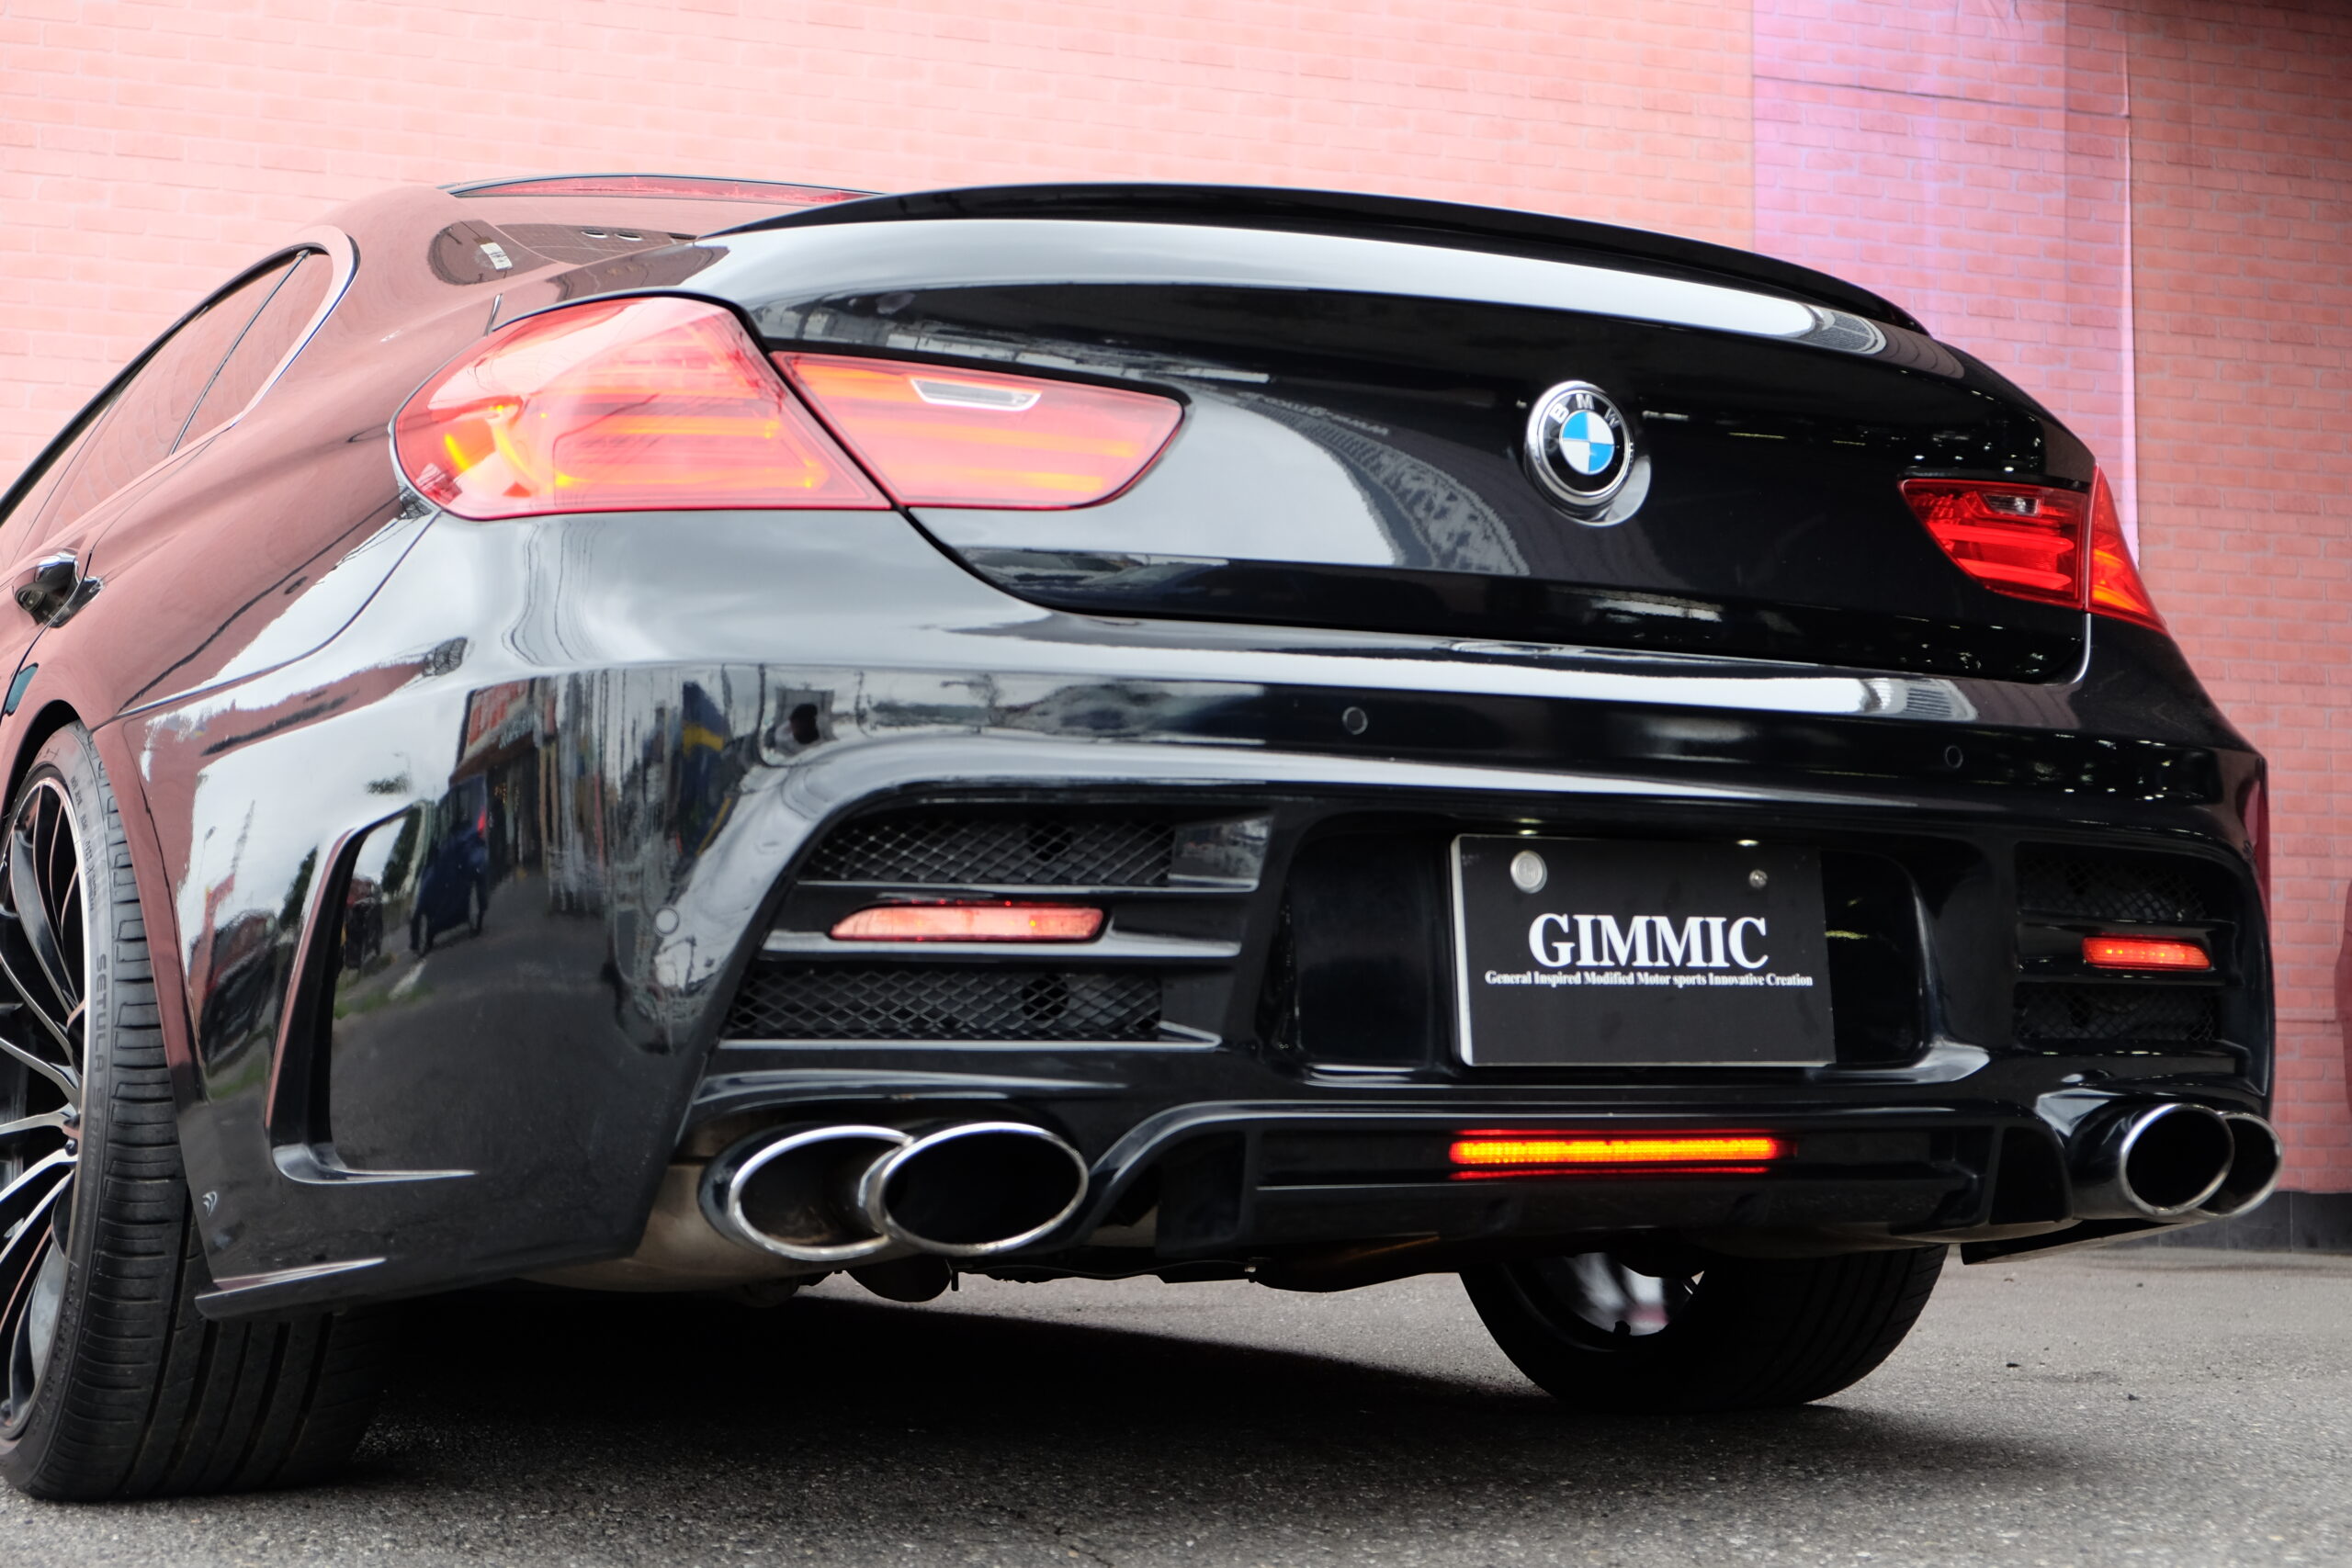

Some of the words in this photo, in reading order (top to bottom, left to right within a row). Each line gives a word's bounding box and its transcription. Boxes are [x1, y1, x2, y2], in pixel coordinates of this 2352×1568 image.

[1549, 393, 1621, 429] BMW
[1529, 913, 1769, 969] GIMMIC
[1485, 970, 1532, 985] General
[1533, 971, 1582, 987] Inspired
[1584, 971, 1634, 986] Modified
[1636, 971, 1671, 986] Motor
[1672, 973, 1707, 988] sports
[1708, 972, 1765, 986] Innovative
[1766, 973, 1813, 987] Creation
[95, 953, 107, 1073] SETULA
